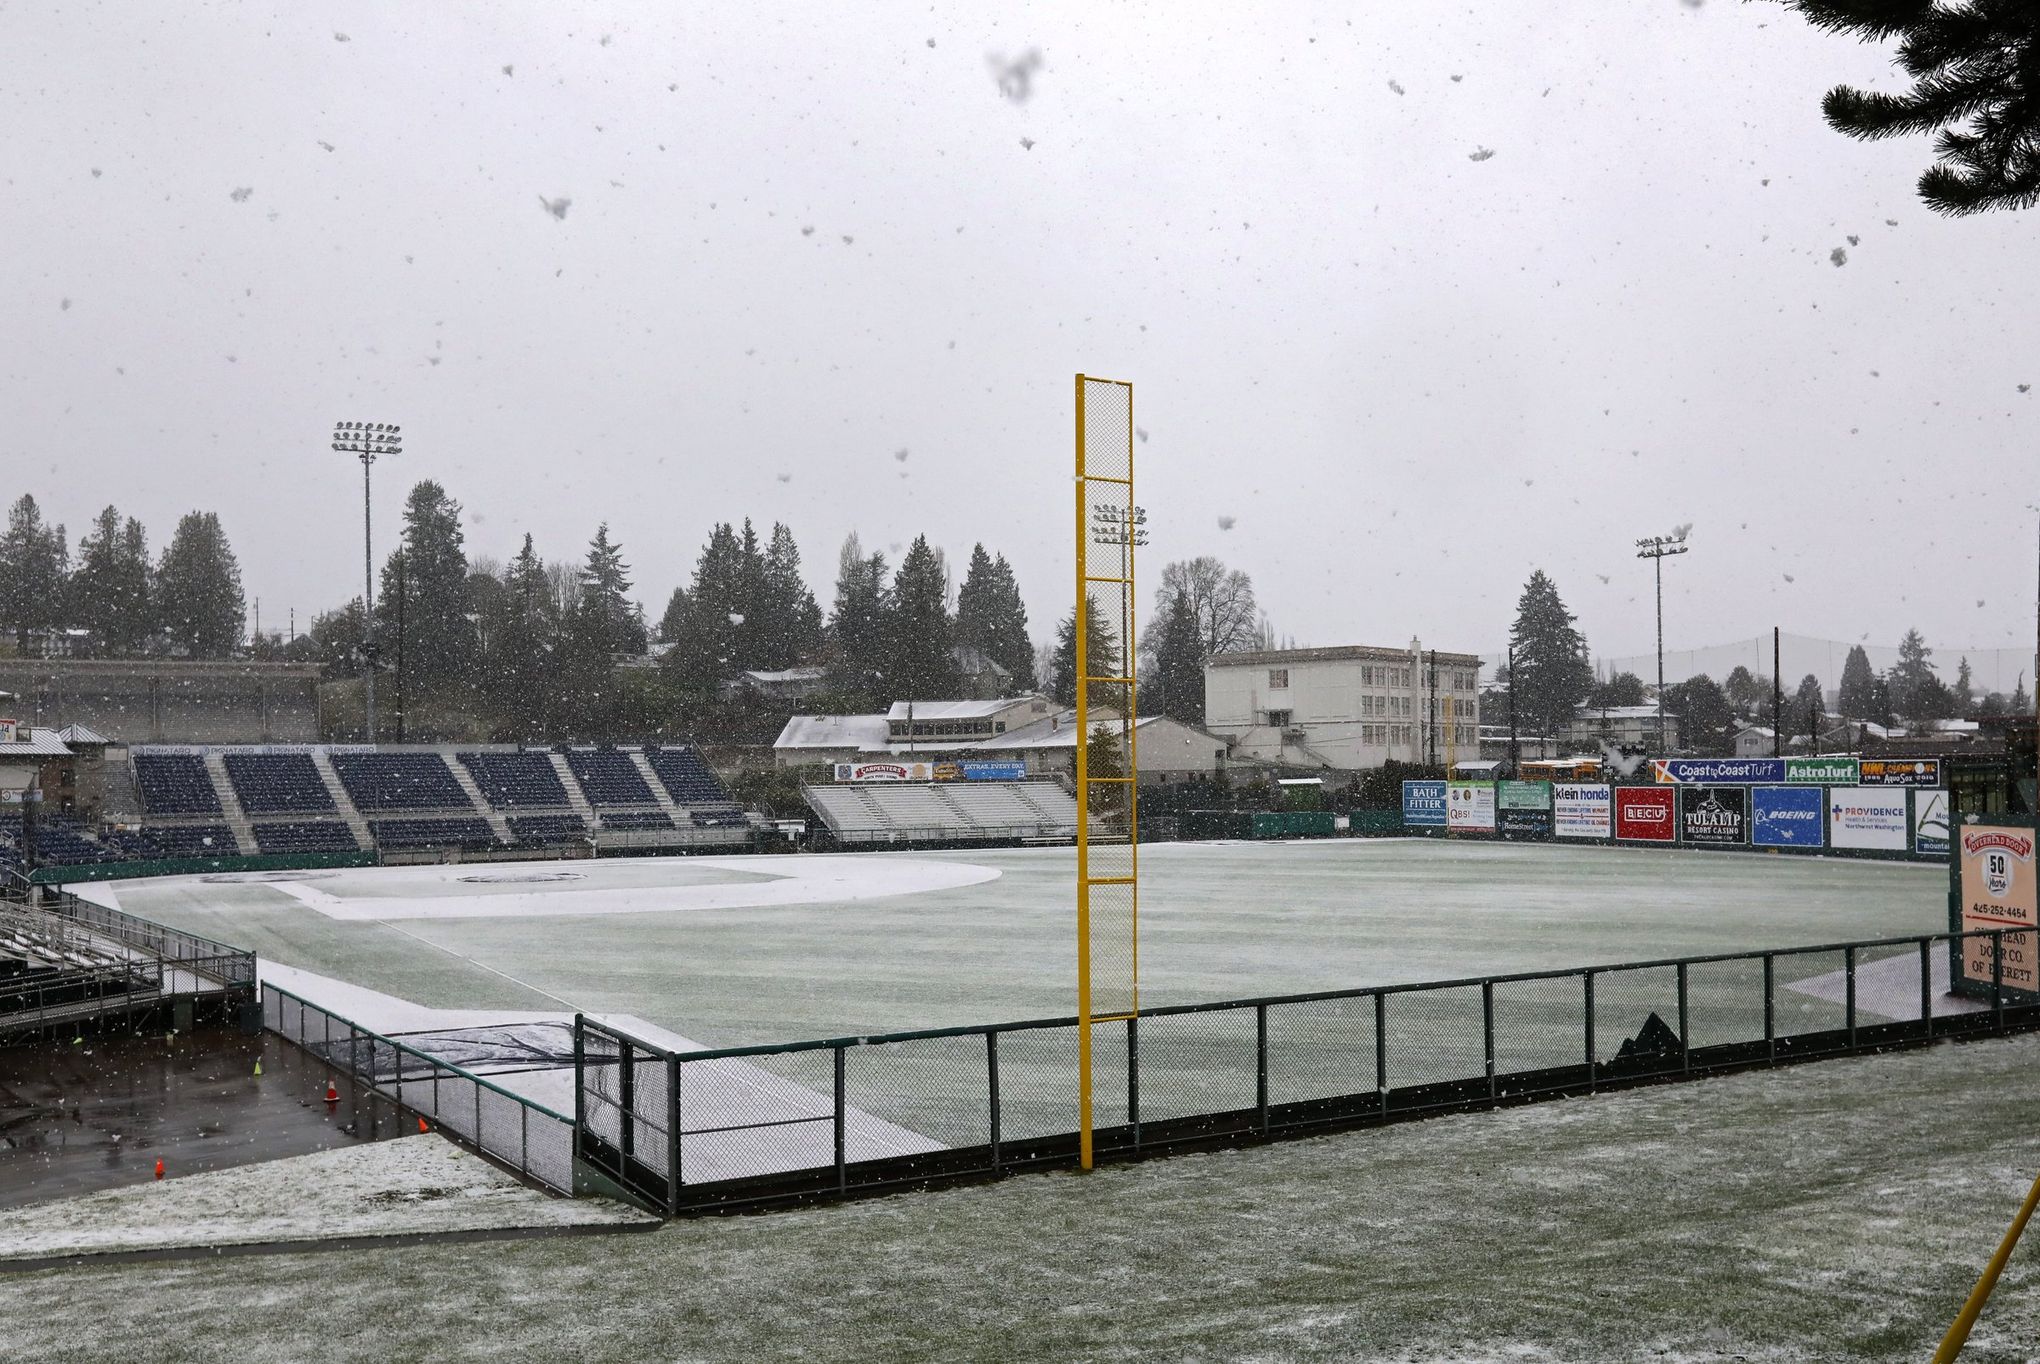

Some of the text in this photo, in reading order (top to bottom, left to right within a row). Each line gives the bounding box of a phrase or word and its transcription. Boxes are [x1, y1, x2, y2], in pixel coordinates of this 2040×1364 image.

[862, 765, 902, 773] CARPENTERS
[1788, 765, 1854, 778] AstroTurf
[1413, 788, 1438, 798] BATH
[1555, 787, 1579, 800] klein
[1580, 787, 1609, 800] honda
[1409, 799, 1441, 809] FITTER
[1627, 808, 1662, 819] BECU
[1769, 810, 1816, 820] BOEING
[1845, 807, 1904, 817] PROVIDENCE
[1686, 812, 1741, 826] TULALIP
[1687, 826, 1739, 835] RESORT CASINO
[1845, 823, 1905, 832] Northwest Washington
[1971, 834, 2025, 855] OVERHEAD DOOR
[1990, 855, 2004, 875] 50
[1972, 960, 2032, 982] OF EERETT
